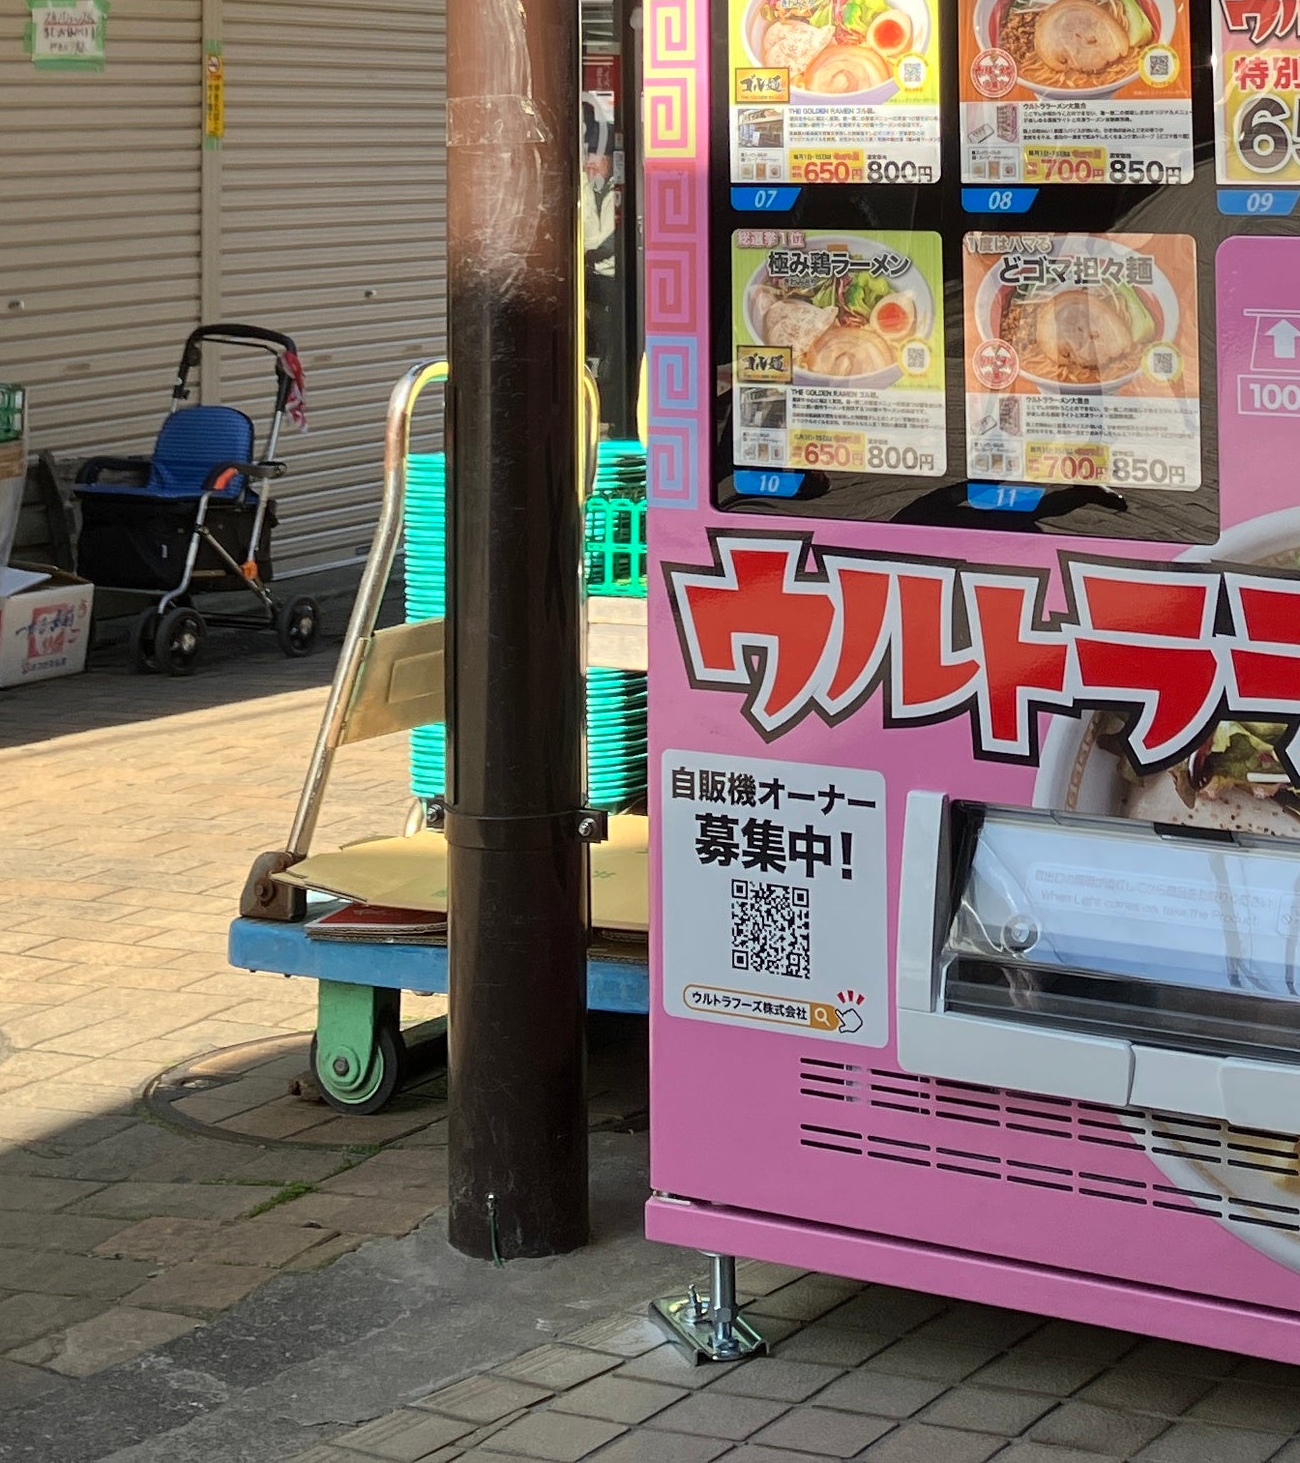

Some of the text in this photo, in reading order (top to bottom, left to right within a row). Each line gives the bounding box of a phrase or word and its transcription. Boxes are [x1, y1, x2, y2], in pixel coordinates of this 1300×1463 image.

[867, 160, 933, 184] 800円
[1109, 159, 1182, 185] 850円
[754, 190, 777, 208] 07
[988, 191, 1012, 210] 08
[1246, 193, 1273, 213] 09
[736, 230, 805, 249] 総選挙1位
[768, 250, 913, 278] 極み鶏ラーメン
[999, 255, 1154, 286] どゴマ担々麺
[868, 446, 935, 471] 800円
[1112, 457, 1186, 483] 850円
[758, 474, 780, 493] 10
[996, 487, 1017, 507] 11
[671, 766, 876, 816] 自販機オーナー
[695, 812, 853, 881] 募集中!
[691, 990, 808, 1021] ウルトラフーズ株式会社
